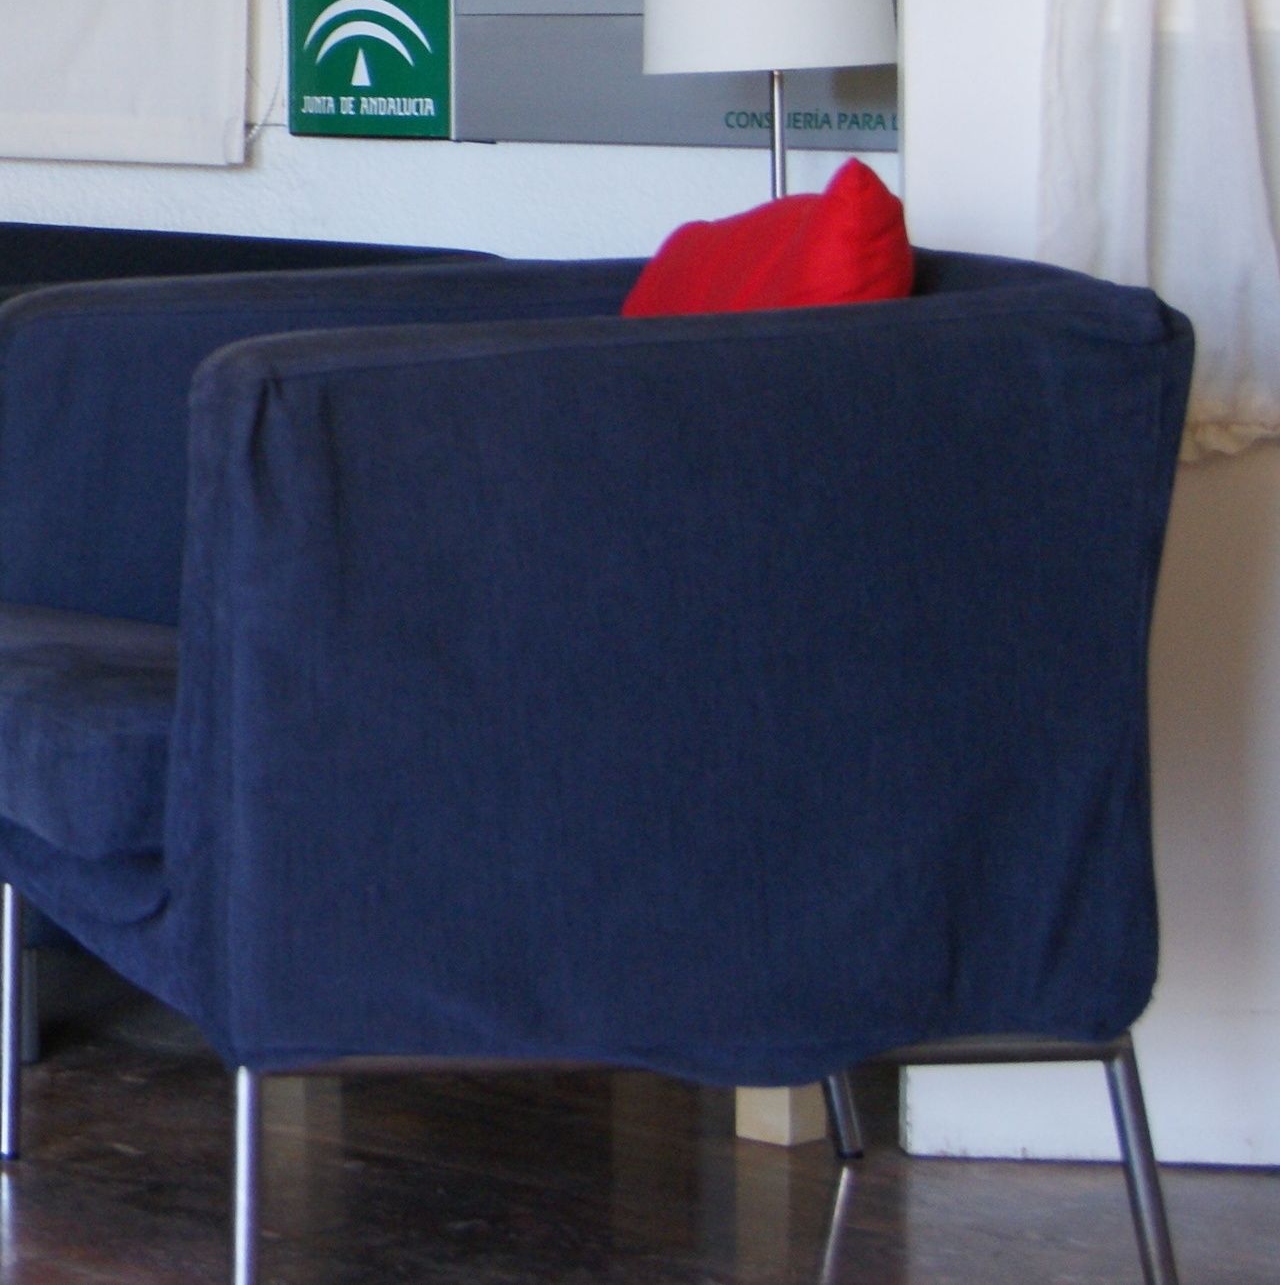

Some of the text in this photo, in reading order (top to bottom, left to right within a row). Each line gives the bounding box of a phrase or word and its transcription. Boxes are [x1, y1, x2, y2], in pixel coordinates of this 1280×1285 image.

[301, 96, 436, 116] JUNTA DE ANDALUCIA
[724, 108, 833, 131] CONSJERÍA
[836, 111, 886, 131] PARA
